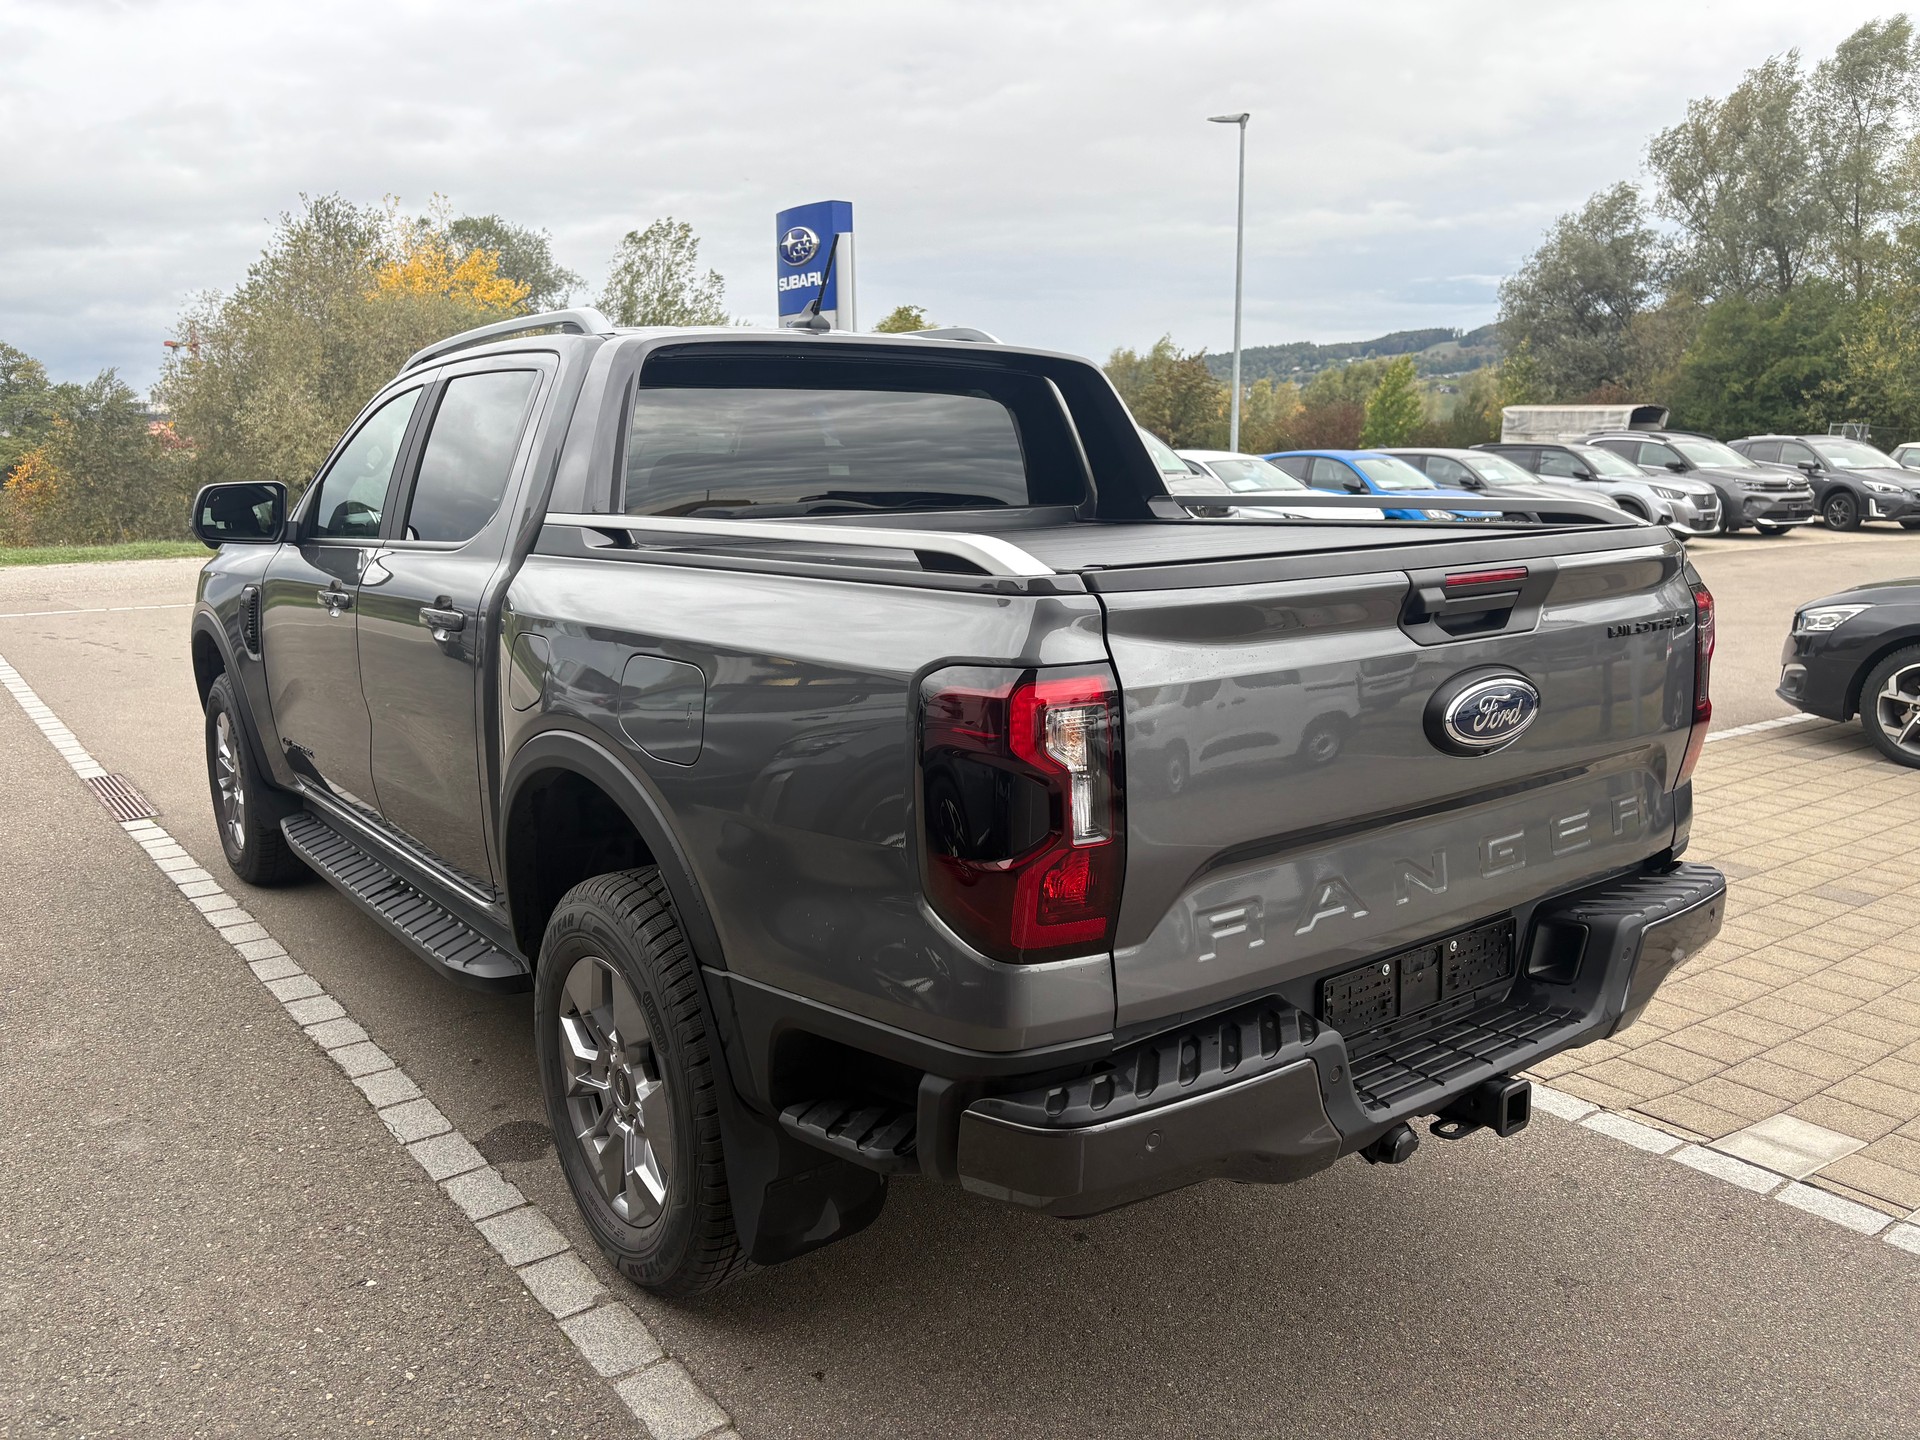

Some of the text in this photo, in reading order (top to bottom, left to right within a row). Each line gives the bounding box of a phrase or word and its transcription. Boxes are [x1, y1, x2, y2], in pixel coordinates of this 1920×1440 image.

[1473, 692, 1524, 733] Ford
[1195, 794, 1650, 963] RANGER
[643, 993, 666, 1052] UltraGrip
